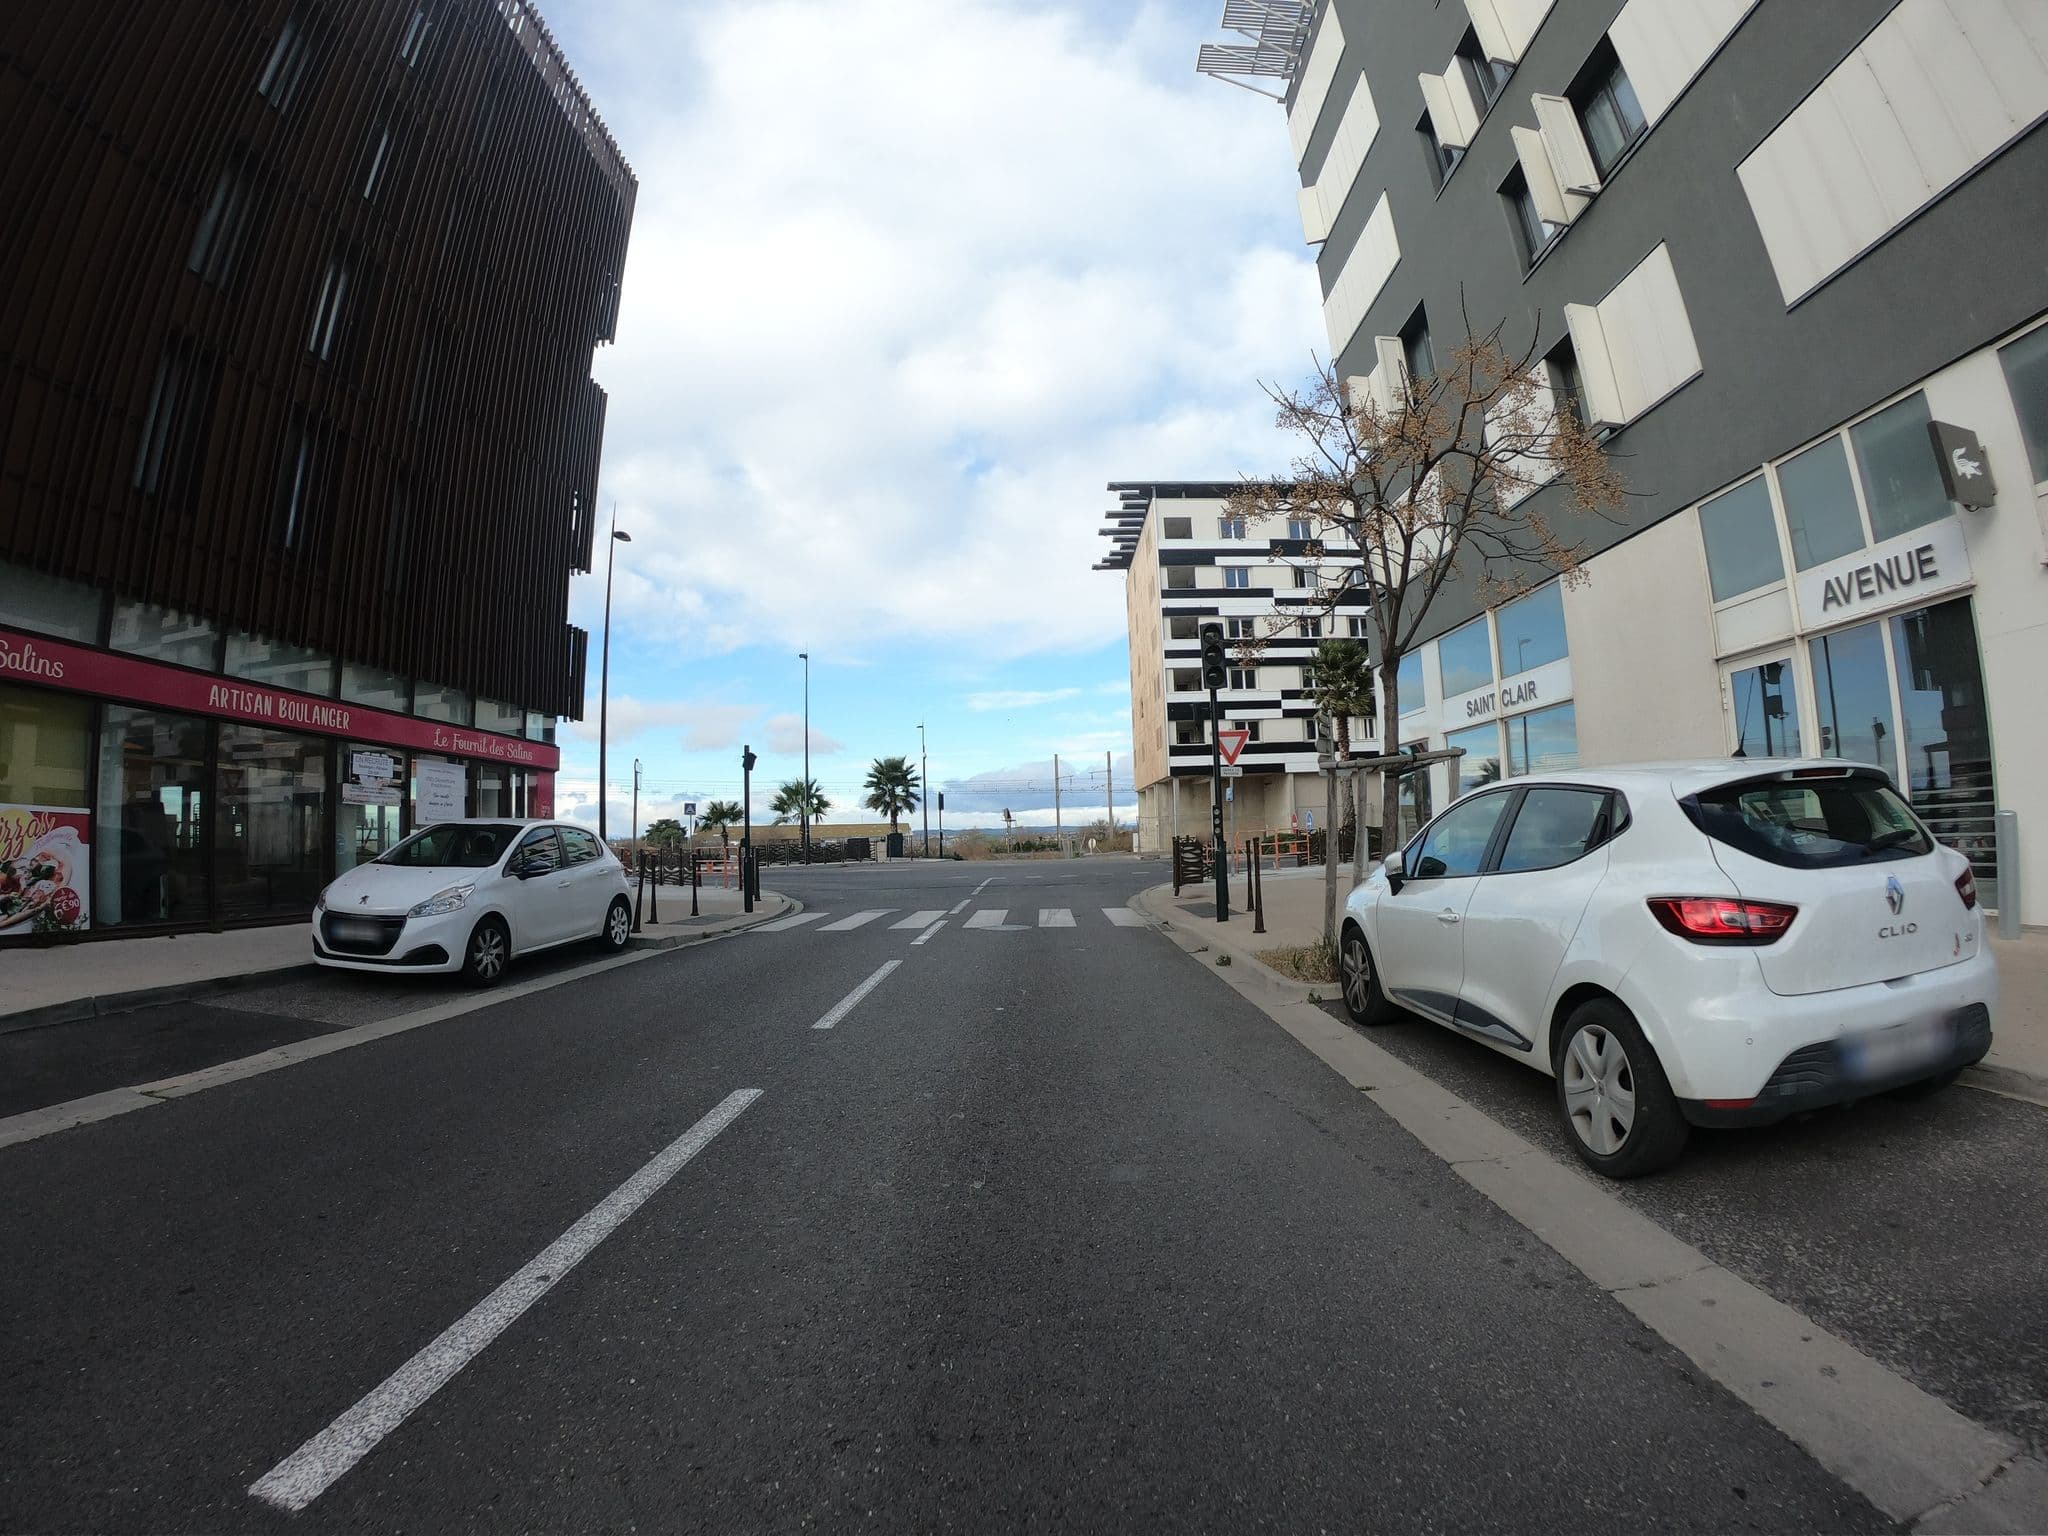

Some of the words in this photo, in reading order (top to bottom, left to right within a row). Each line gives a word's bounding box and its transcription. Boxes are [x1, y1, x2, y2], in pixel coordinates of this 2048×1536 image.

[1822, 543, 1939, 612] AVENUE
[209, 685, 272, 716] ARTISAN
[279, 698, 350, 730] BOULANGER
[1466, 692, 1496, 718] SAINT
[1501, 680, 1538, 707] CLAIR
[433, 728, 449, 747] Le
[452, 733, 488, 753] Fournil
[489, 739, 505, 756] des
[506, 743, 533, 761] Salins
[0, 811, 56, 862] izzas
[1878, 922, 1918, 939] CLIO
